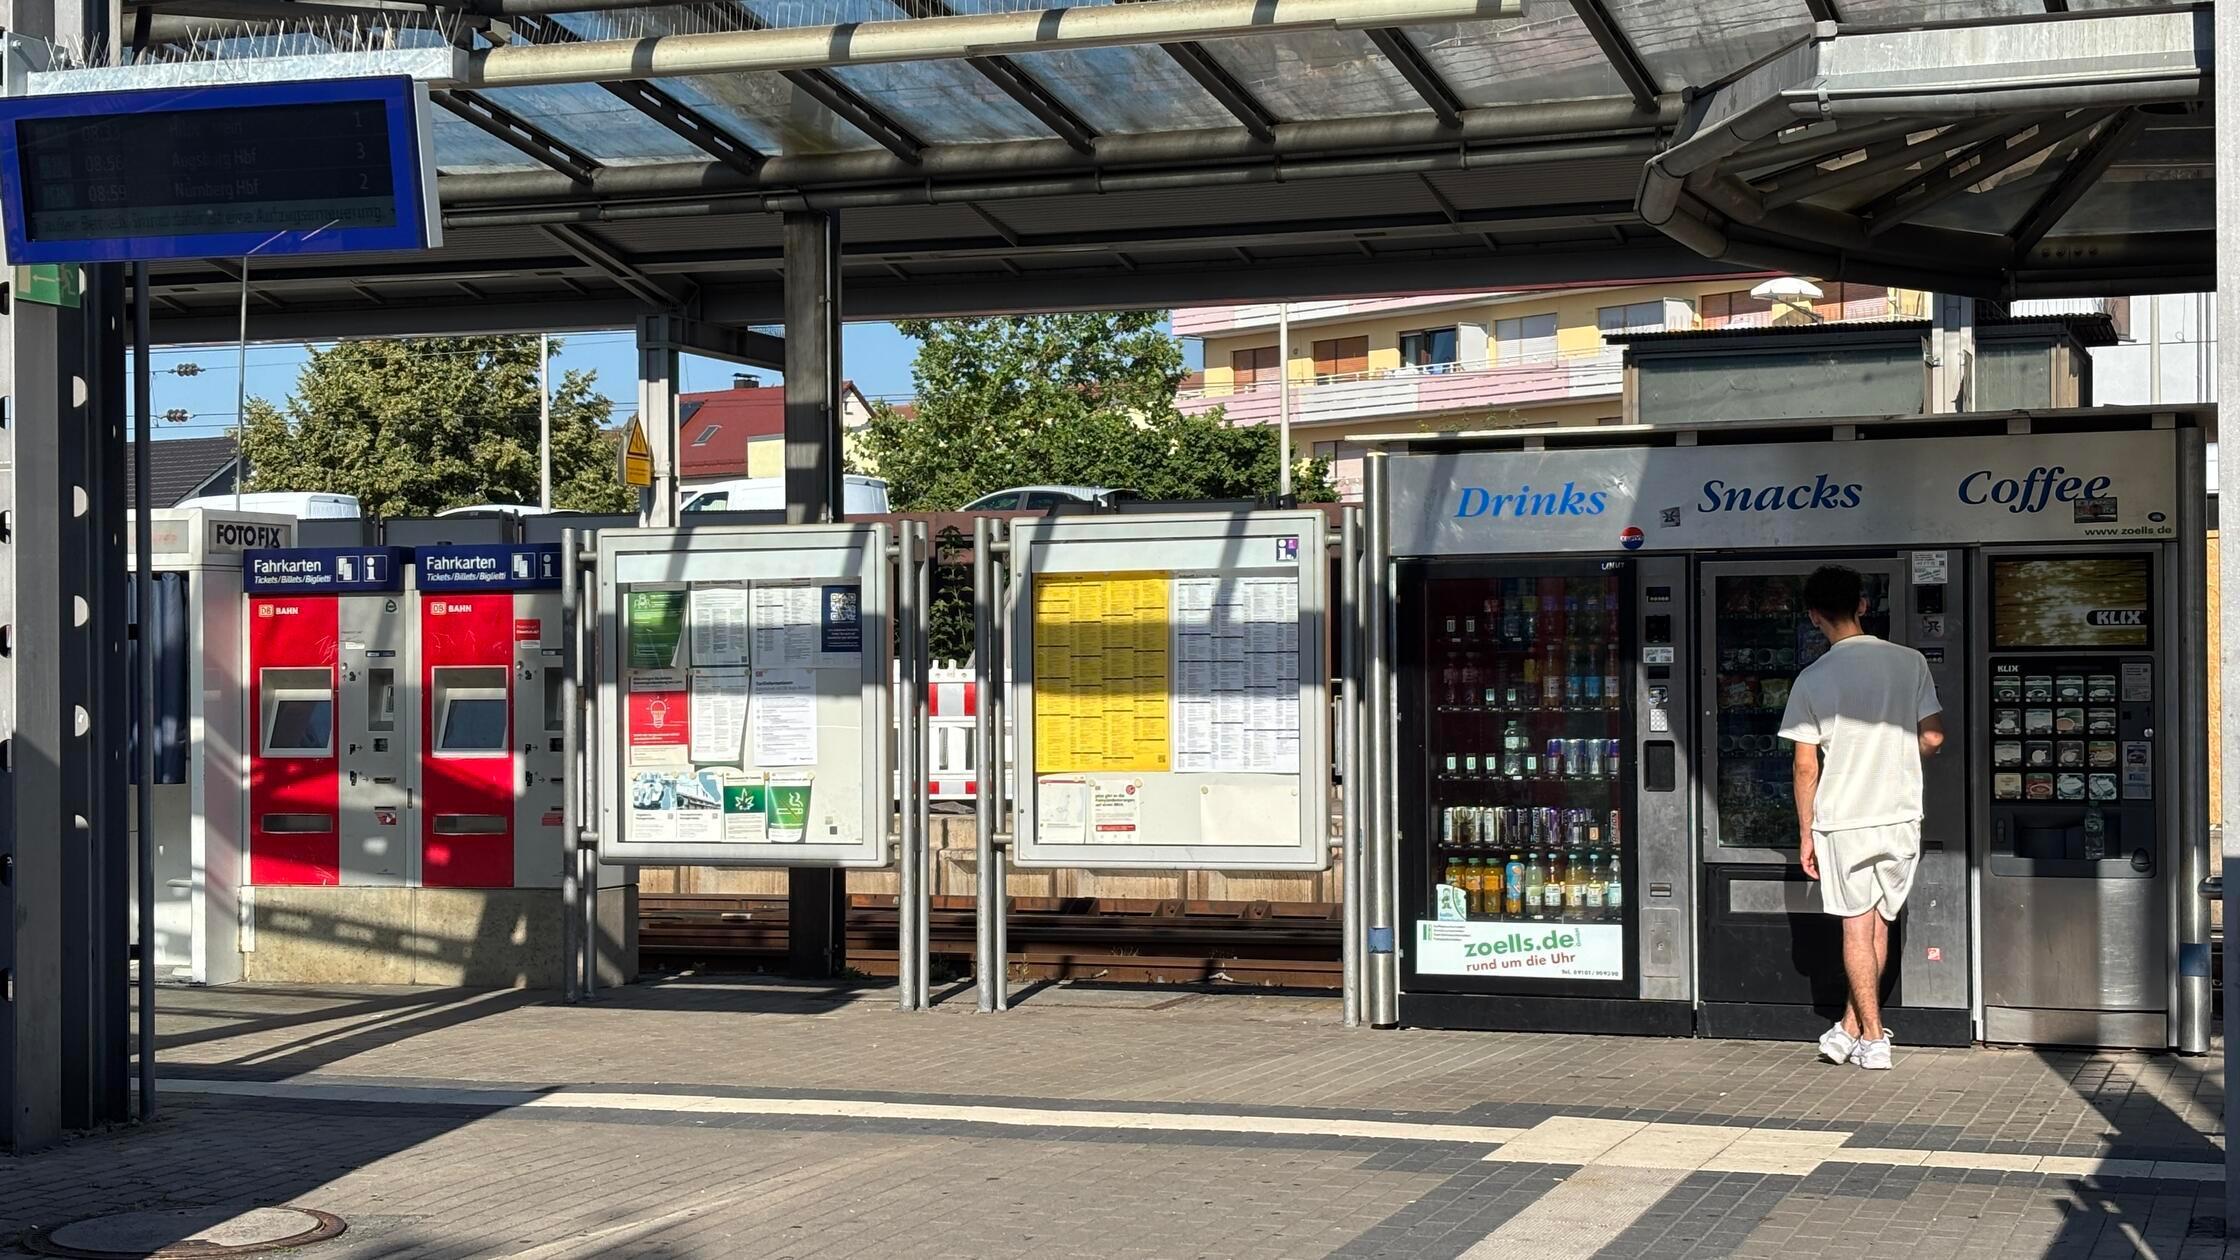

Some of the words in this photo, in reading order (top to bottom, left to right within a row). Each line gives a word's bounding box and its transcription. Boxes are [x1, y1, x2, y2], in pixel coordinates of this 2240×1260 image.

[353, 111, 363, 128] 1
[232, 145, 259, 166] Hbf
[354, 141, 367, 159] 3
[234, 177, 261, 196] Hbf
[358, 173, 370, 190] 2
[1698, 474, 1863, 512] Snacks
[1959, 466, 2110, 513] Coffee
[1454, 481, 1607, 518] Drinks
[216, 524, 280, 548] FOTOFIX
[254, 559, 322, 573] Fahrkarten
[426, 556, 496, 570] Fahrkarten
[254, 574, 332, 584] Tickets/Billets/Biglietti
[426, 572, 506, 581] Tickets/Billets/Biglietti
[2097, 610, 2140, 624] KLIX
[1997, 664, 2019, 673] KLIX
[1464, 930, 1574, 957] zoells.de
[1466, 960, 1497, 971] rund
[1501, 960, 1522, 968] um
[1526, 955, 1546, 965] die
[1551, 952, 1576, 964] Uhr
